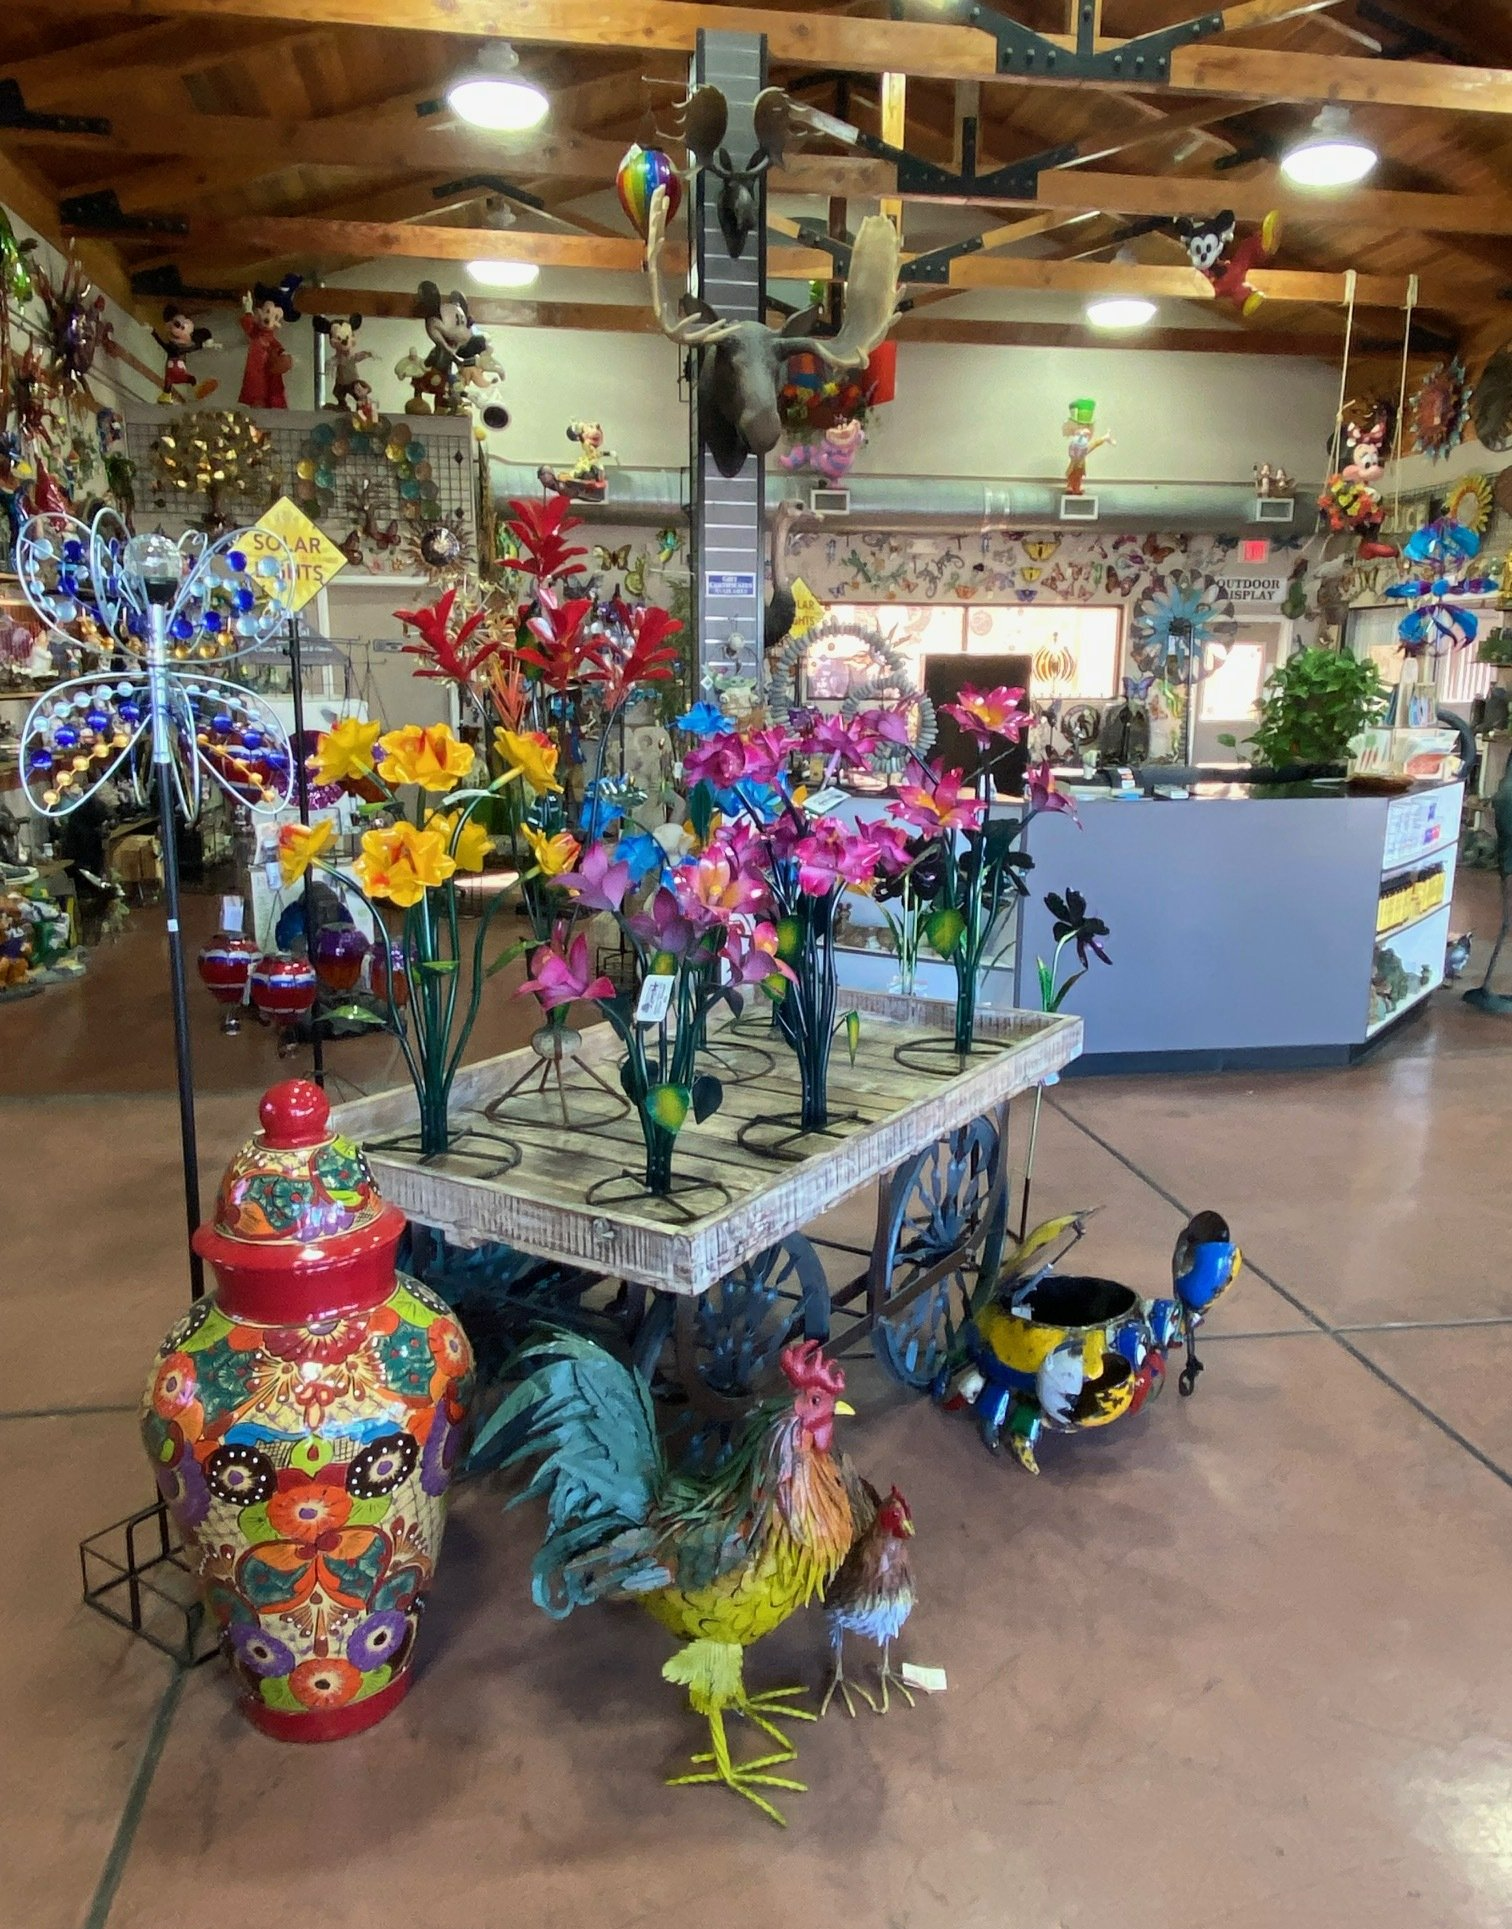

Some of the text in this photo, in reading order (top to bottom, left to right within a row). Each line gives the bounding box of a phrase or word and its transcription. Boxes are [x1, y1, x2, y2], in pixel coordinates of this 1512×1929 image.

[253, 533, 321, 554] SOLAR
[1217, 579, 1280, 590] OUTDOOR
[1229, 590, 1275, 600] ISPLAY
[797, 600, 815, 610] LAR
